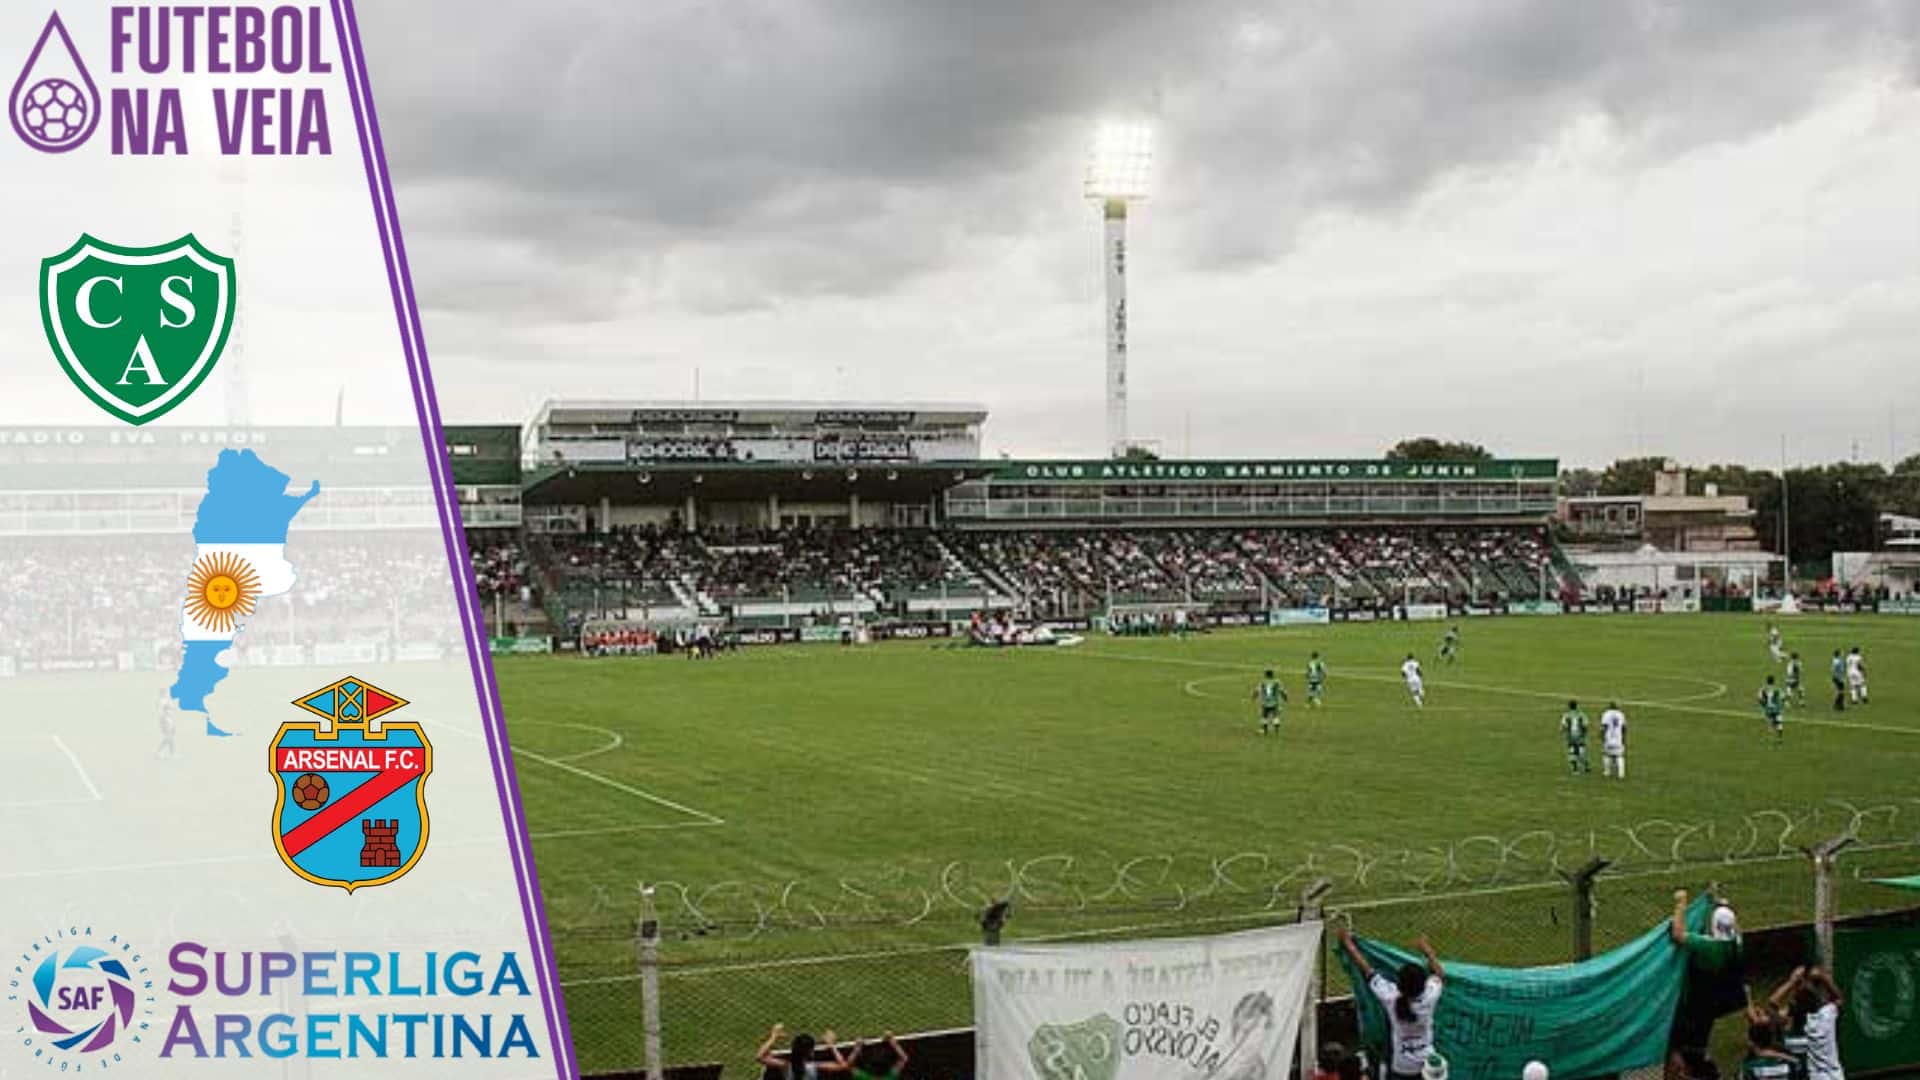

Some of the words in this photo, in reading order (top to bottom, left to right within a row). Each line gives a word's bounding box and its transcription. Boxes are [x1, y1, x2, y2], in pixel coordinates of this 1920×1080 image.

[1026, 465, 1083, 477] CLUB
[1225, 465, 1350, 476] SARMIENTO
[1366, 464, 1390, 476] DE
